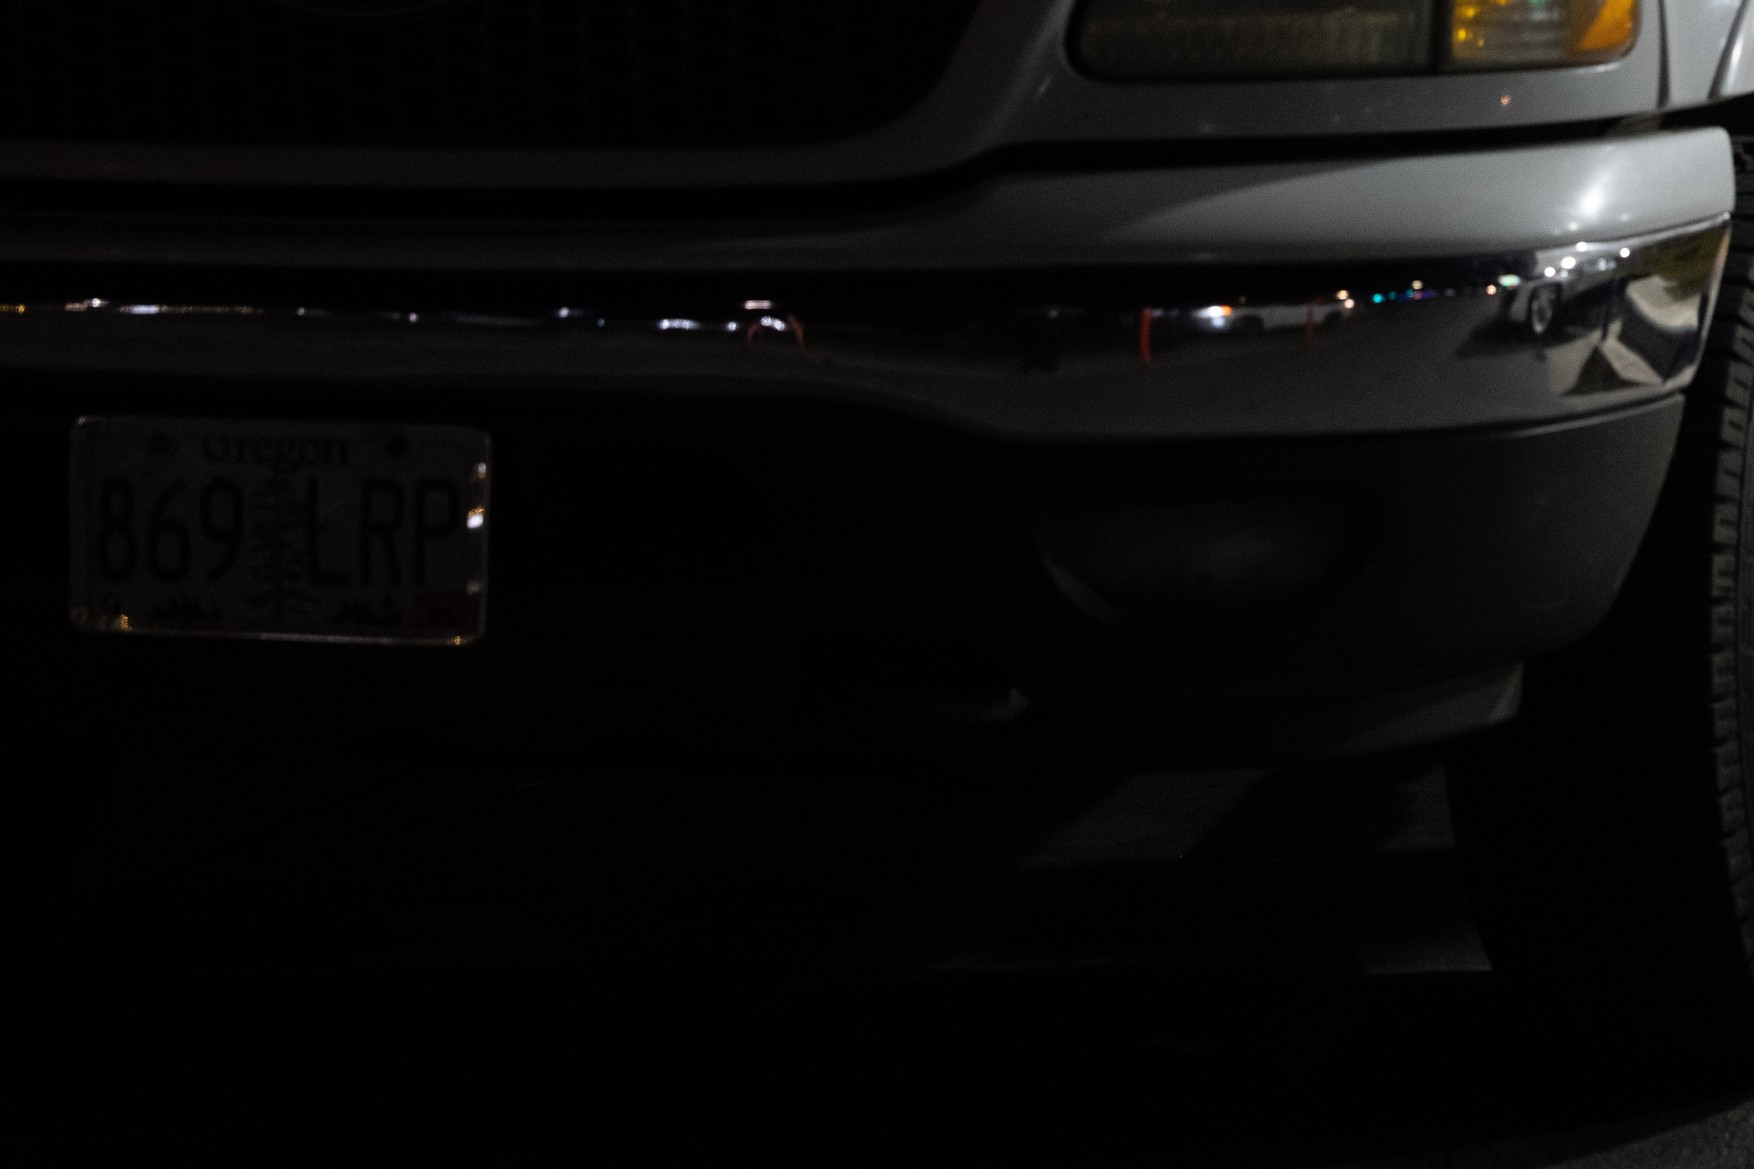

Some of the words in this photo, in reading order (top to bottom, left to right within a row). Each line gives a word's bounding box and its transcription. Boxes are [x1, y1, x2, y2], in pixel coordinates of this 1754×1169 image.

[201, 434, 351, 472] Oregon
[98, 476, 244, 581] 869
[307, 477, 459, 586] LRP
